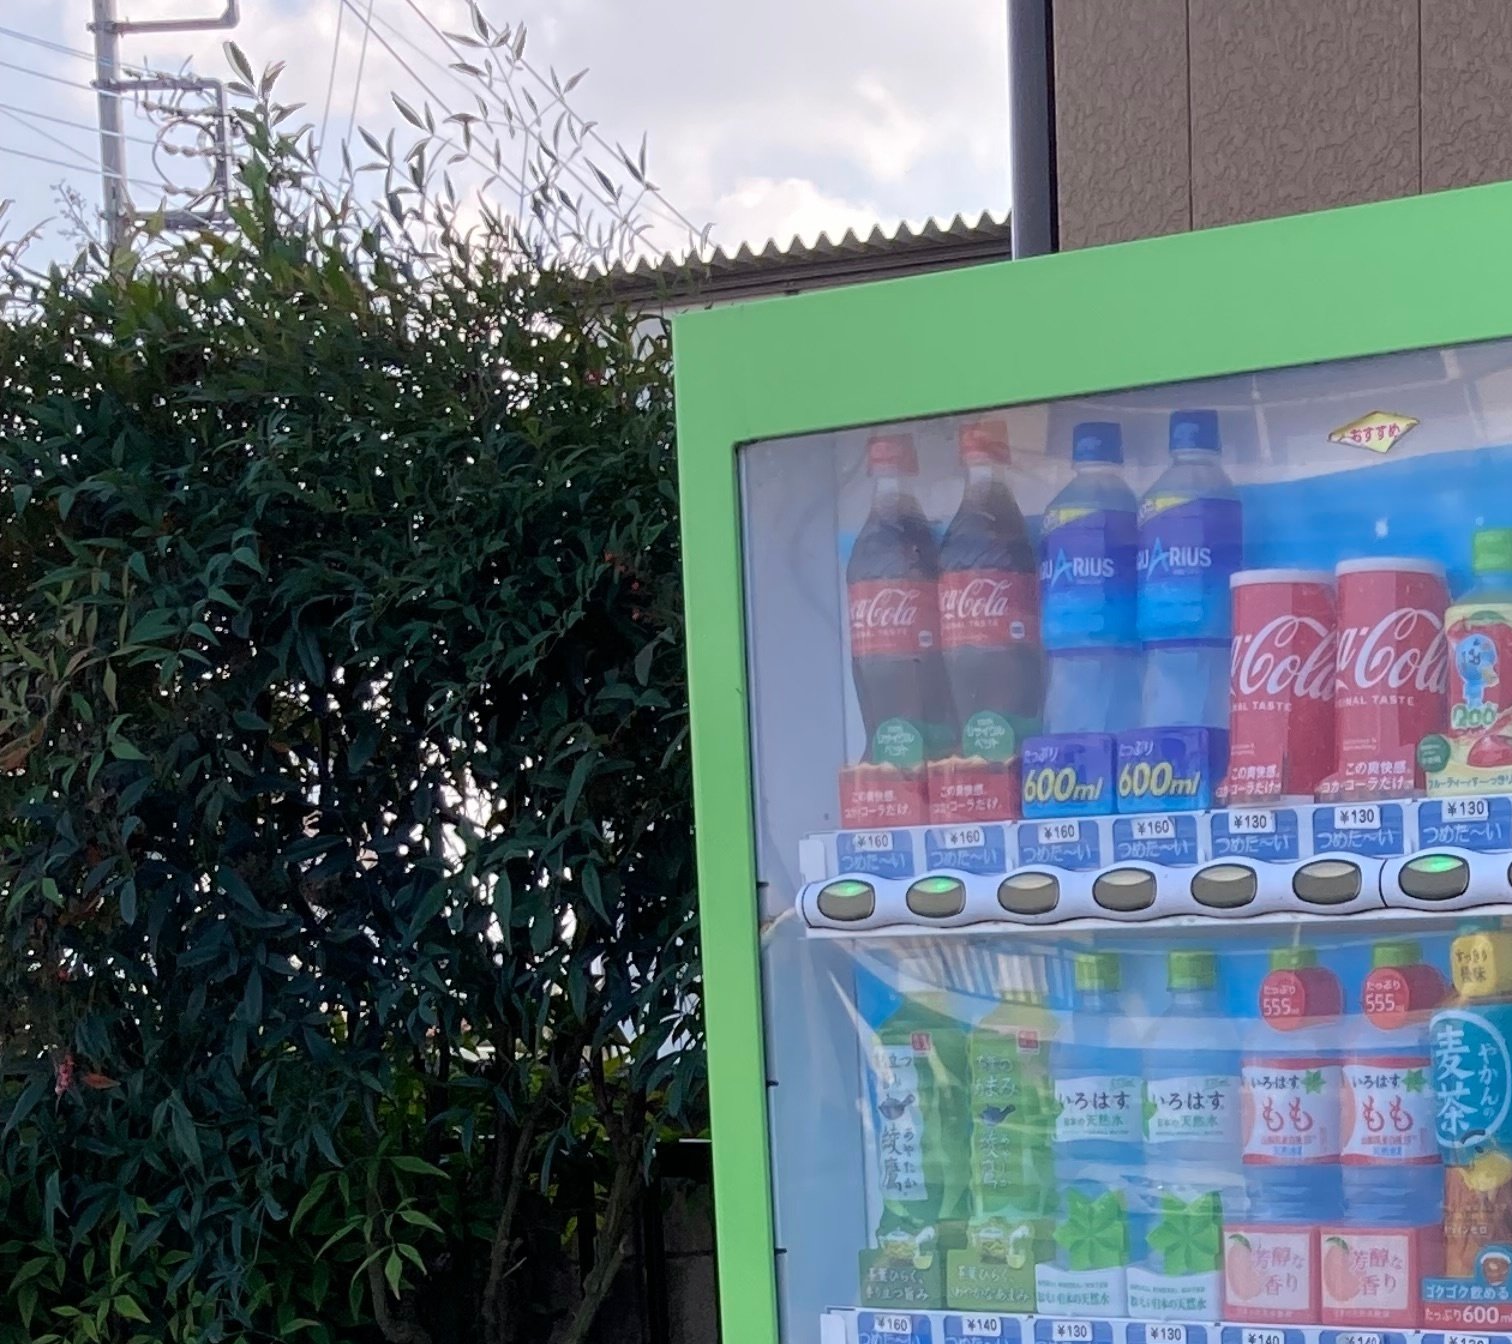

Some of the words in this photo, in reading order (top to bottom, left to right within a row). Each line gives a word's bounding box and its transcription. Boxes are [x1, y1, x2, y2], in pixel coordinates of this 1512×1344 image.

[1350, 423, 1400, 443] おすすめ
[1022, 767, 1104, 803] 600ml
[1118, 762, 1201, 798] 600ml
[1339, 807, 1376, 825] ¥130
[1447, 800, 1486, 817] ¥130
[1136, 820, 1171, 836] ¥160
[1233, 813, 1269, 830] ¥130
[950, 829, 981, 845] ¥160
[1043, 824, 1076, 841] ¥160
[857, 834, 889, 849] ¥160
[1251, 1074, 1300, 1090] いろはす
[1353, 1073, 1402, 1090] いろはす
[1436, 1024, 1479, 1136] 麦茶
[1478, 1043, 1499, 1119] やかんの
[1058, 1090, 1131, 1111] いろはす
[1152, 1090, 1225, 1111] いろはす
[1262, 1095, 1314, 1133] もも
[1363, 1095, 1414, 1133] もも
[1265, 1273, 1299, 1297] 香り
[1363, 1273, 1398, 1297] 香り
[877, 1317, 908, 1332] ¥160
[966, 1318, 998, 1332] ¥140
[1056, 1324, 1088, 1339] ¥130
[1150, 1328, 1182, 1342] ¥130
